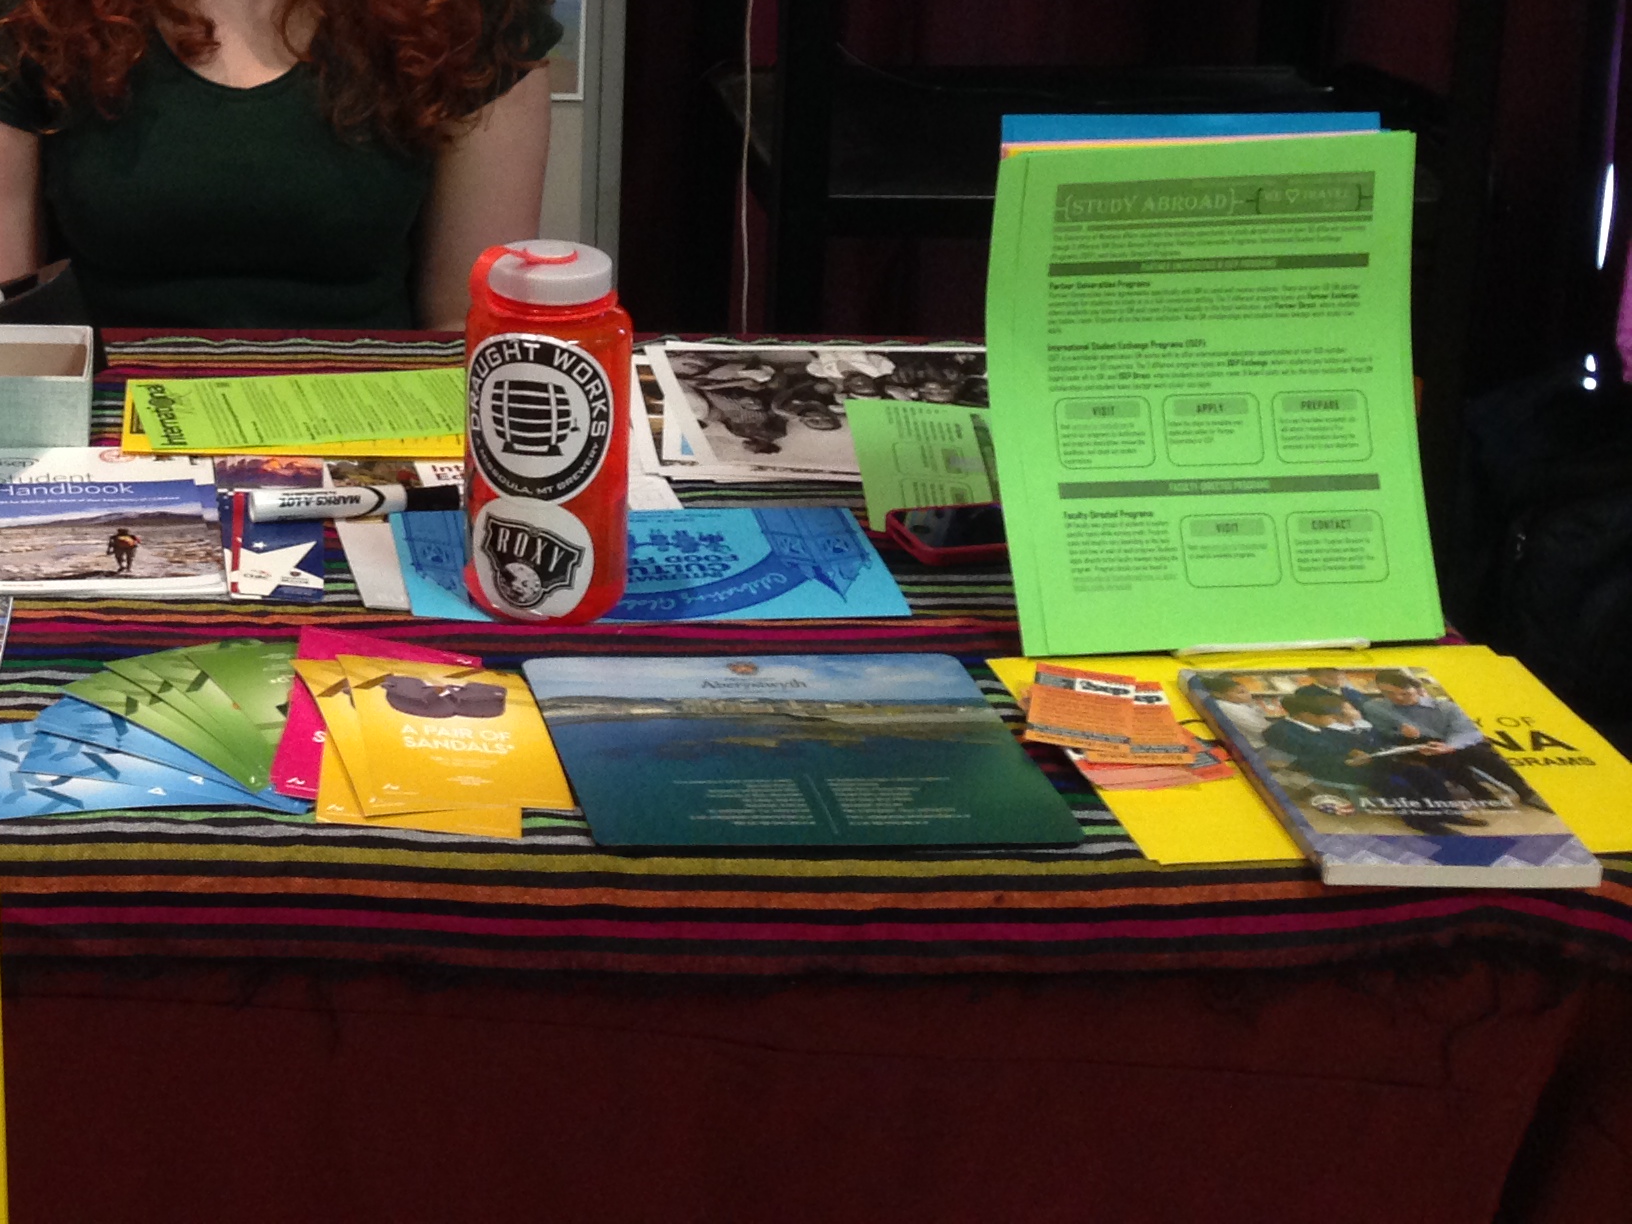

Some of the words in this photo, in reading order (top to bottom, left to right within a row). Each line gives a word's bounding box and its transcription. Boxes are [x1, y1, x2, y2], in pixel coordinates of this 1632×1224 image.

[1071, 194, 1138, 217] STUDY
[1140, 190, 1228, 213] ABROAD
[470, 342, 542, 433] DRAUGHT
[552, 347, 608, 438] WORKS
[1092, 405, 1116, 417] VISIT
[1195, 402, 1225, 414] APPLY
[555, 443, 600, 492] BREWERY
[1310, 519, 1352, 531] CONTACT
[497, 526, 566, 573] ROXY
[627, 562, 732, 575] CULTU
[1496, 716, 1537, 728] OF
[402, 724, 415, 735] A
[423, 724, 472, 739] PAIR
[479, 729, 511, 742] OF
[1506, 755, 1597, 768] GRAMS
[1359, 796, 1376, 808] A
[1378, 796, 1422, 809] Life
[1425, 796, 1514, 811] Inspired
